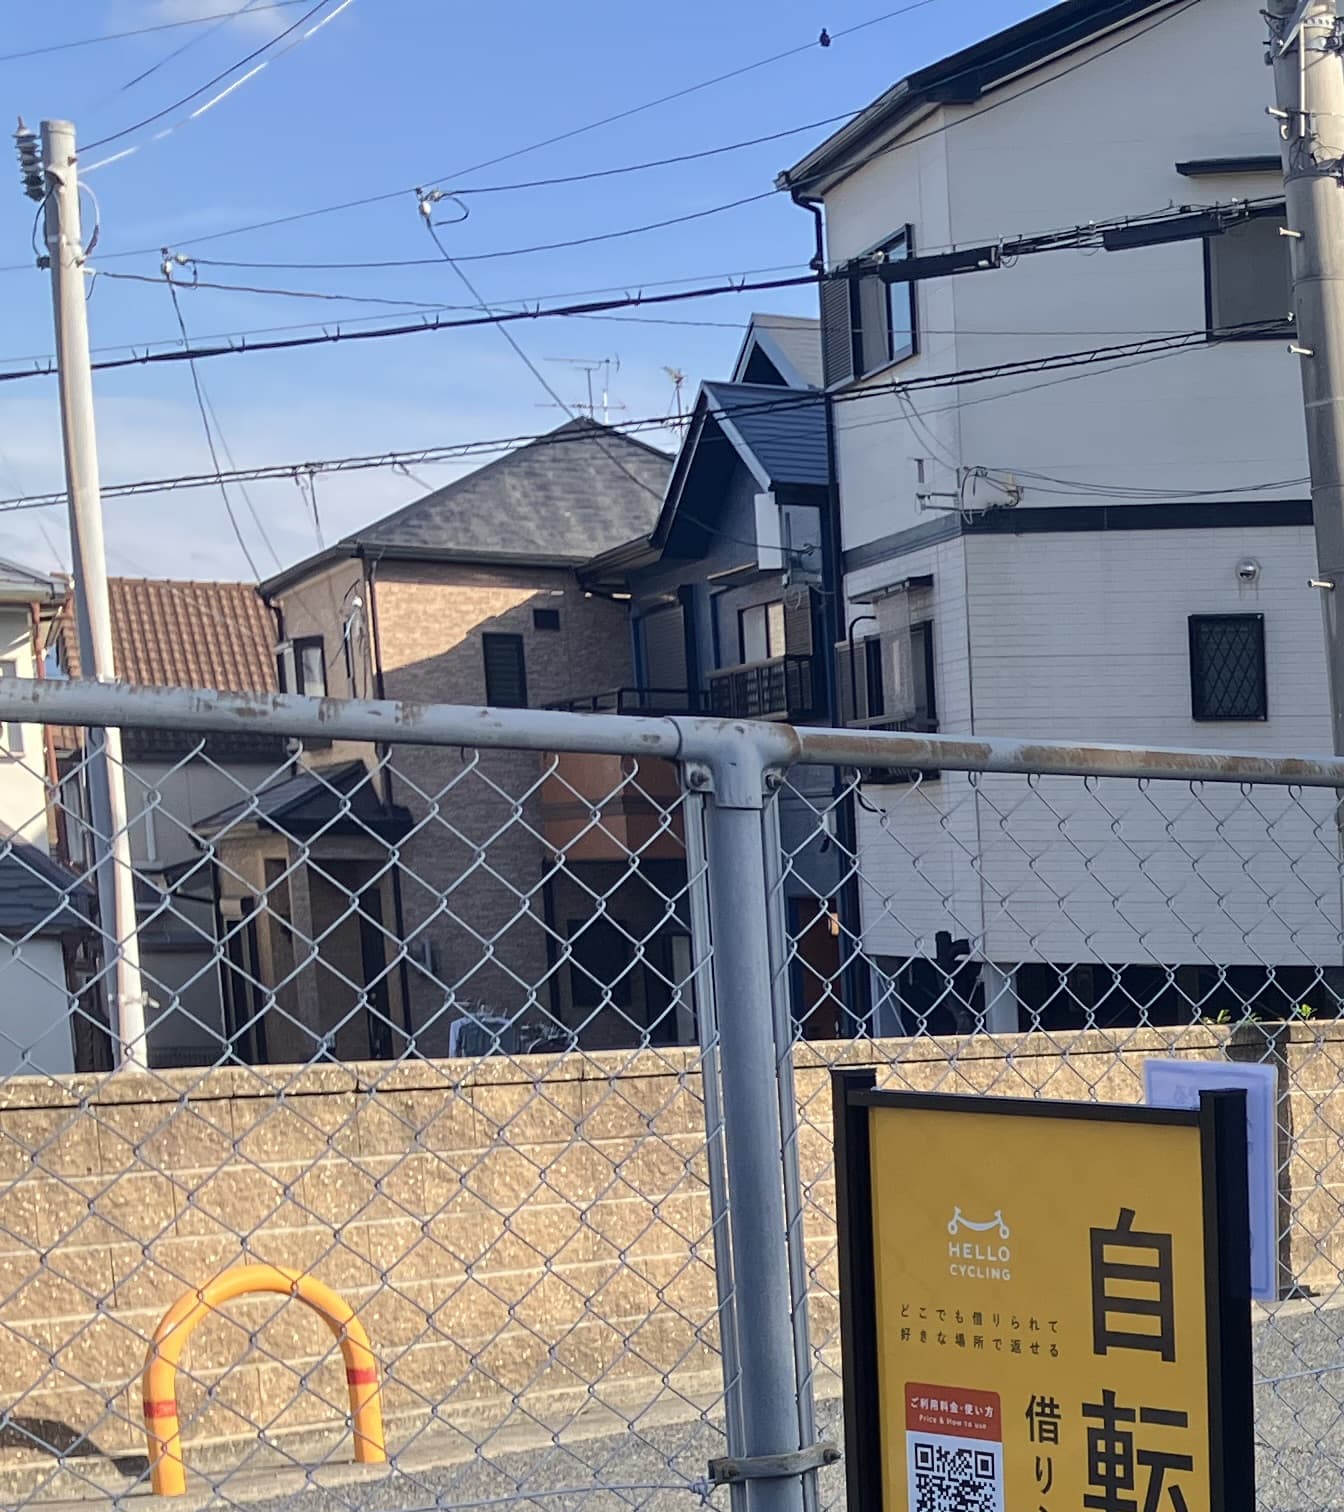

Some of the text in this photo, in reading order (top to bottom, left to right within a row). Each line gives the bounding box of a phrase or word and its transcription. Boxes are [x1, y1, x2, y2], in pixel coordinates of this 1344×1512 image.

[947, 1241, 1011, 1263] HELLO
[949, 1263, 1011, 1282] CYCLING
[900, 1304, 1059, 1334] どこでも借りられて
[900, 1327, 1059, 1358] 好きな場所で返せる
[919, 1414, 937, 1424] Price
[946, 1417, 962, 1426] How
[964, 1420, 973, 1428] to
[974, 1422, 987, 1430] use
